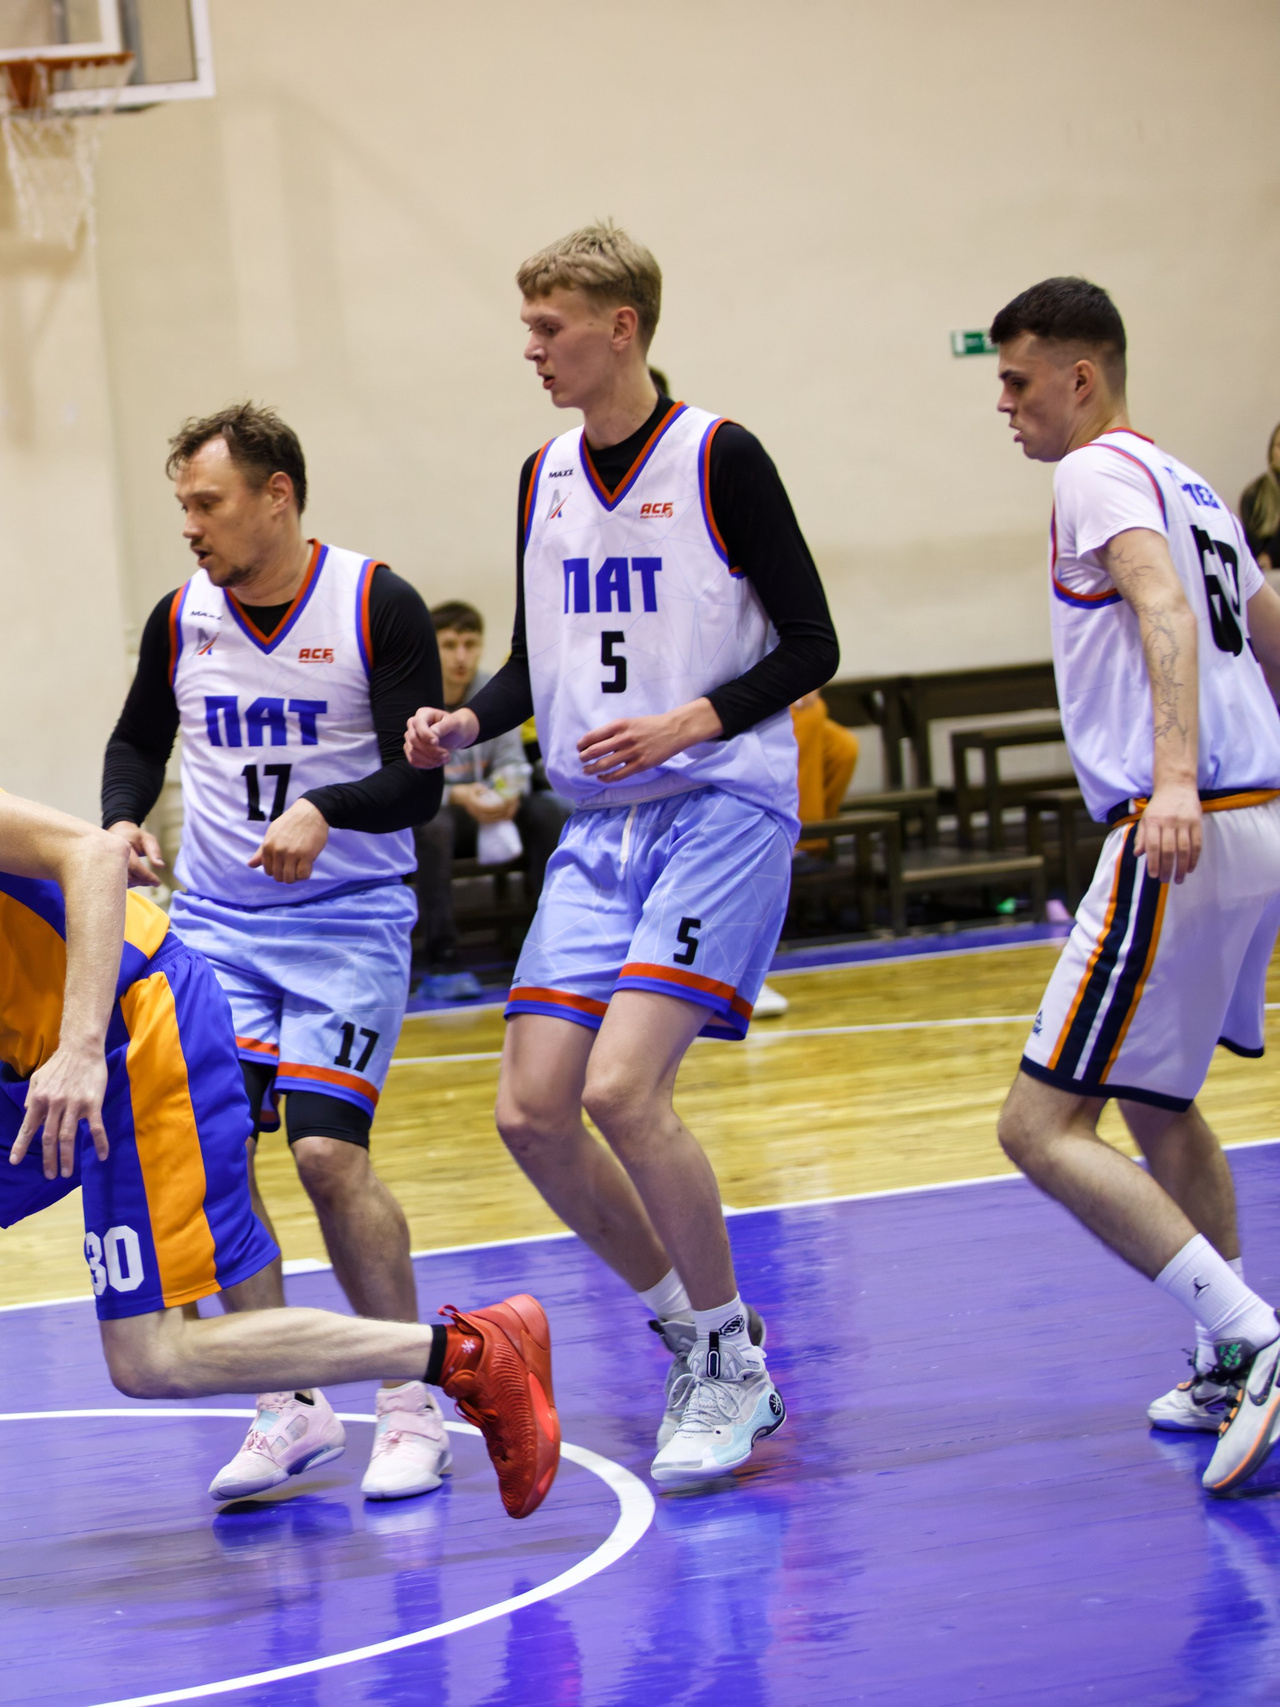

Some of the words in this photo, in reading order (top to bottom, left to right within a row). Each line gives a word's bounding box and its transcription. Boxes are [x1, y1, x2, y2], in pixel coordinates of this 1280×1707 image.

[562, 557, 663, 614] ПАТ
[601, 630, 627, 693] 5
[204, 695, 328, 747] ПАТ
[241, 763, 293, 822] 17
[673, 916, 702, 966] 5
[333, 1021, 380, 1073] 17
[85, 1224, 145, 1296] 30
